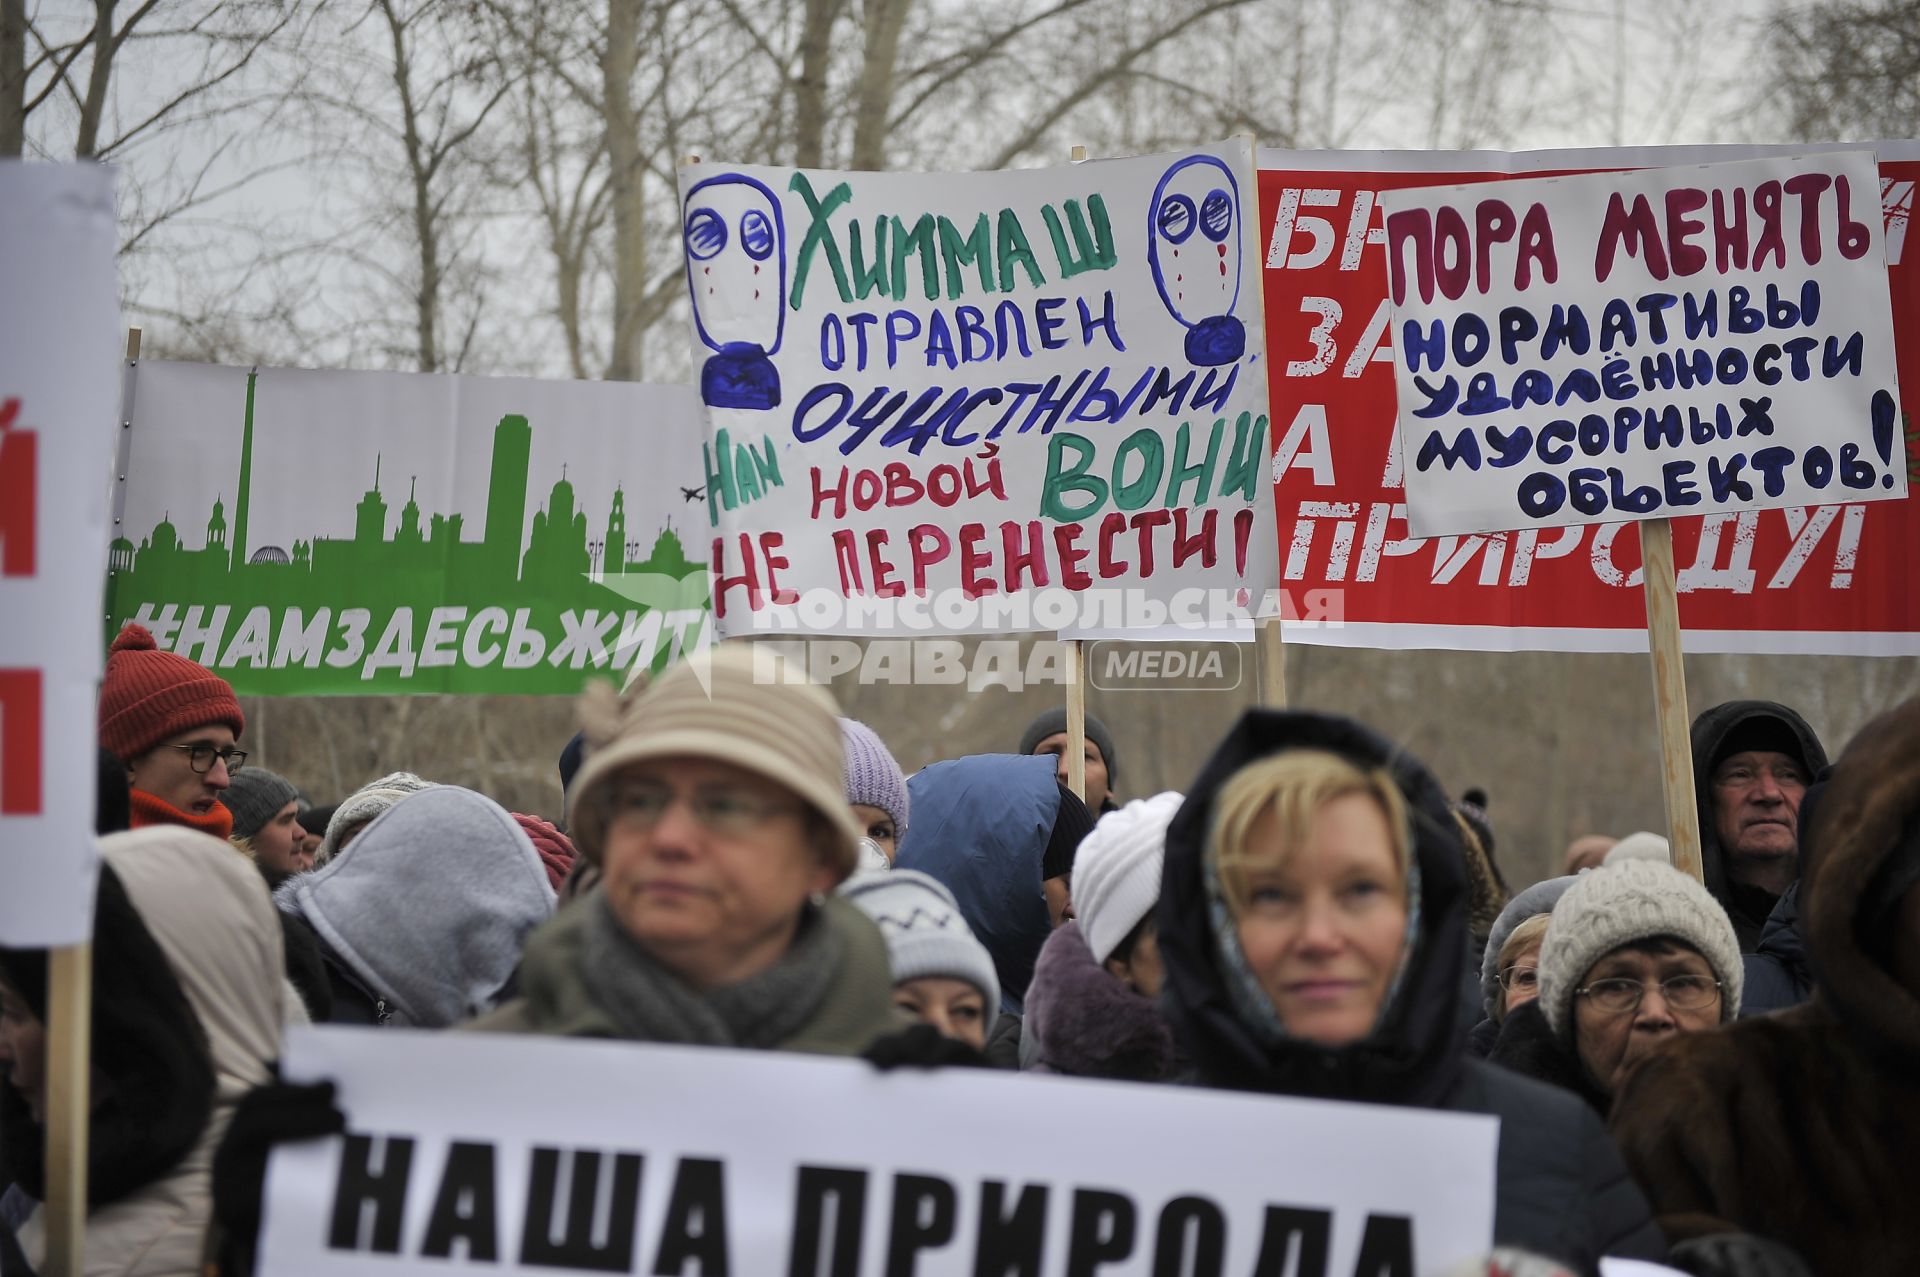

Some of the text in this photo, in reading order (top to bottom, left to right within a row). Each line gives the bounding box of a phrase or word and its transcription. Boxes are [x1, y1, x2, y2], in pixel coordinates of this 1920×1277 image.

[1387, 199, 1559, 306] ПОРА
[1594, 172, 1872, 284] МЕНЯТЬ
[820, 291, 1127, 372] ОТРАВЛЕН
[1402, 279, 1821, 374] НОРМАТИВЫ
[791, 364, 1239, 457] ОЧИСТНЫМИ
[1411, 331, 1865, 419] УДАЛЁННОСТИ
[810, 443, 1007, 519] НОВОЙ
[1039, 411, 1268, 524] ВОНИ
[1272, 404, 1336, 486] А
[1415, 396, 1776, 474] МУСОРНЫХ
[712, 508, 1254, 619] НЕ ПЕРЕНЕСТИ!
[1285, 501, 1867, 594] ПРИРОДУ!
[120, 602, 712, 678] #НАМЗДЕСЬЖИТ
[327, 1133, 1416, 1277] НАША ПРИРОДА
